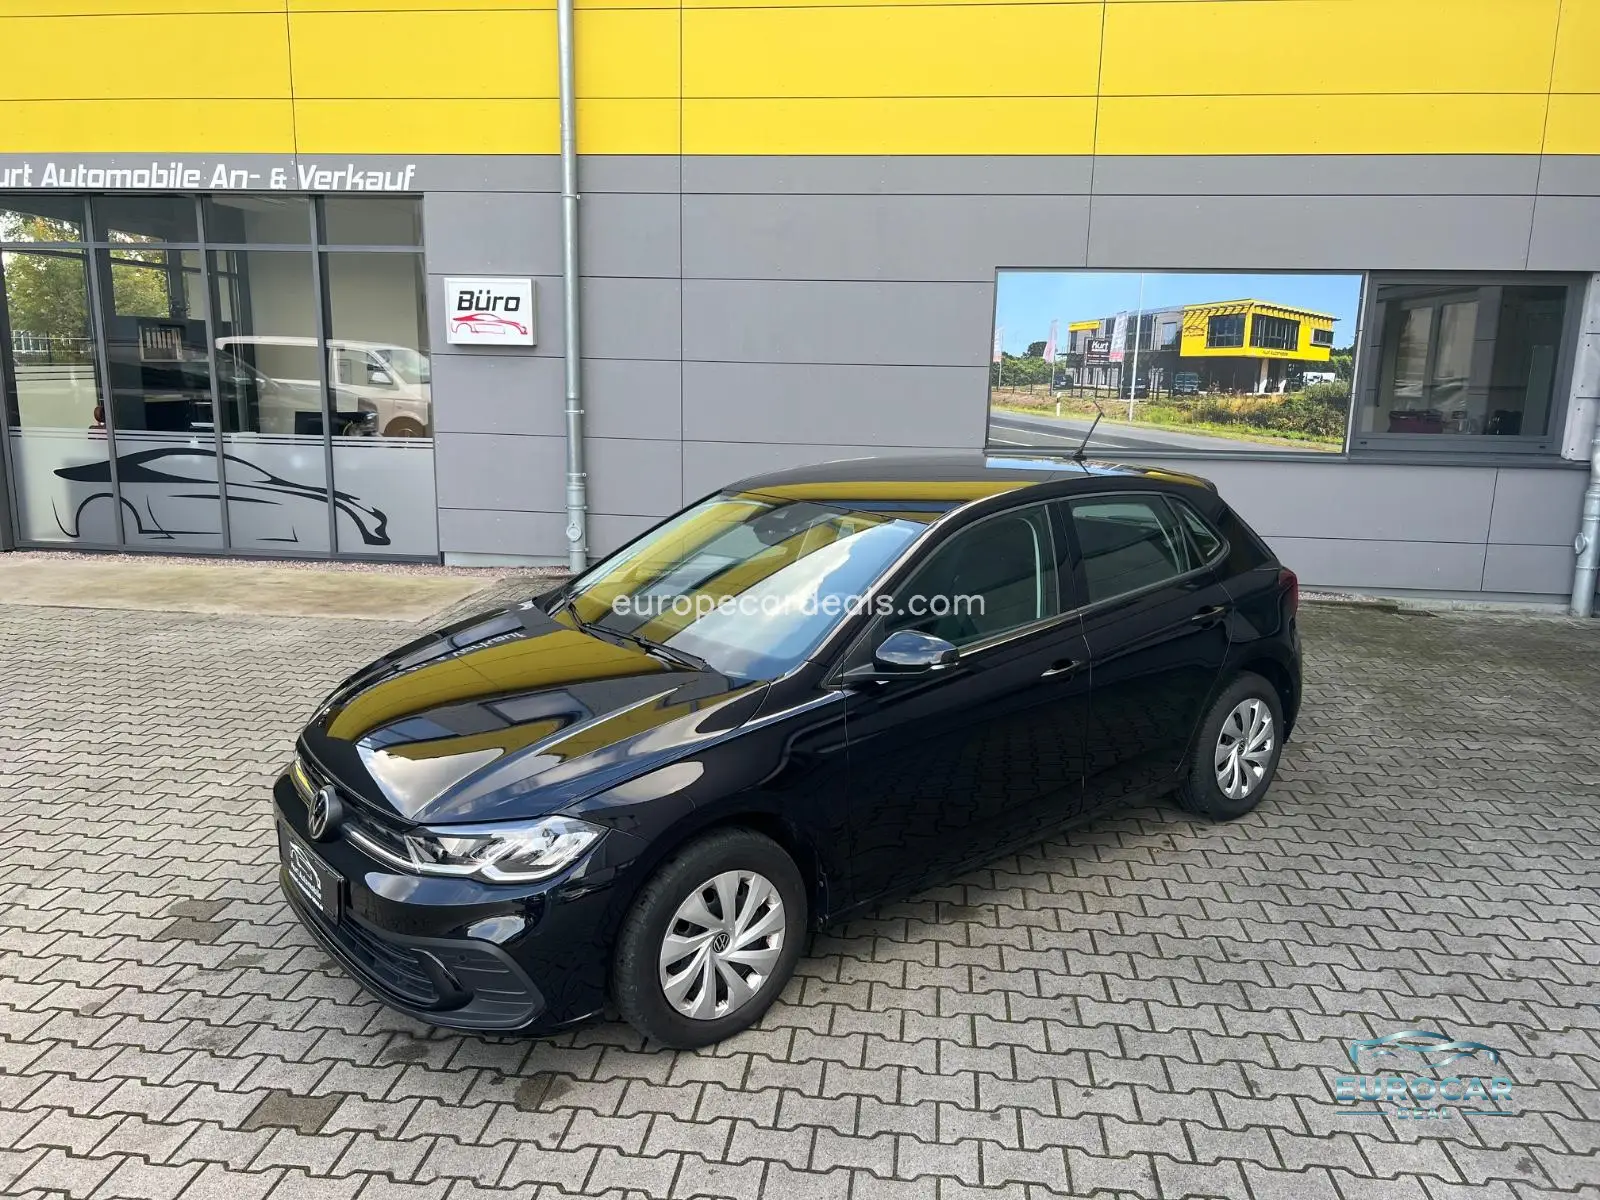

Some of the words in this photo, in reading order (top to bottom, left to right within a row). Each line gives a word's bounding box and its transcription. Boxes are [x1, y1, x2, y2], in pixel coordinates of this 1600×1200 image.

[41, 162, 201, 188] Automobile
[209, 164, 261, 189] An-
[270, 168, 287, 190] &
[297, 164, 416, 191] Verkauf
[457, 290, 520, 311] Büro
